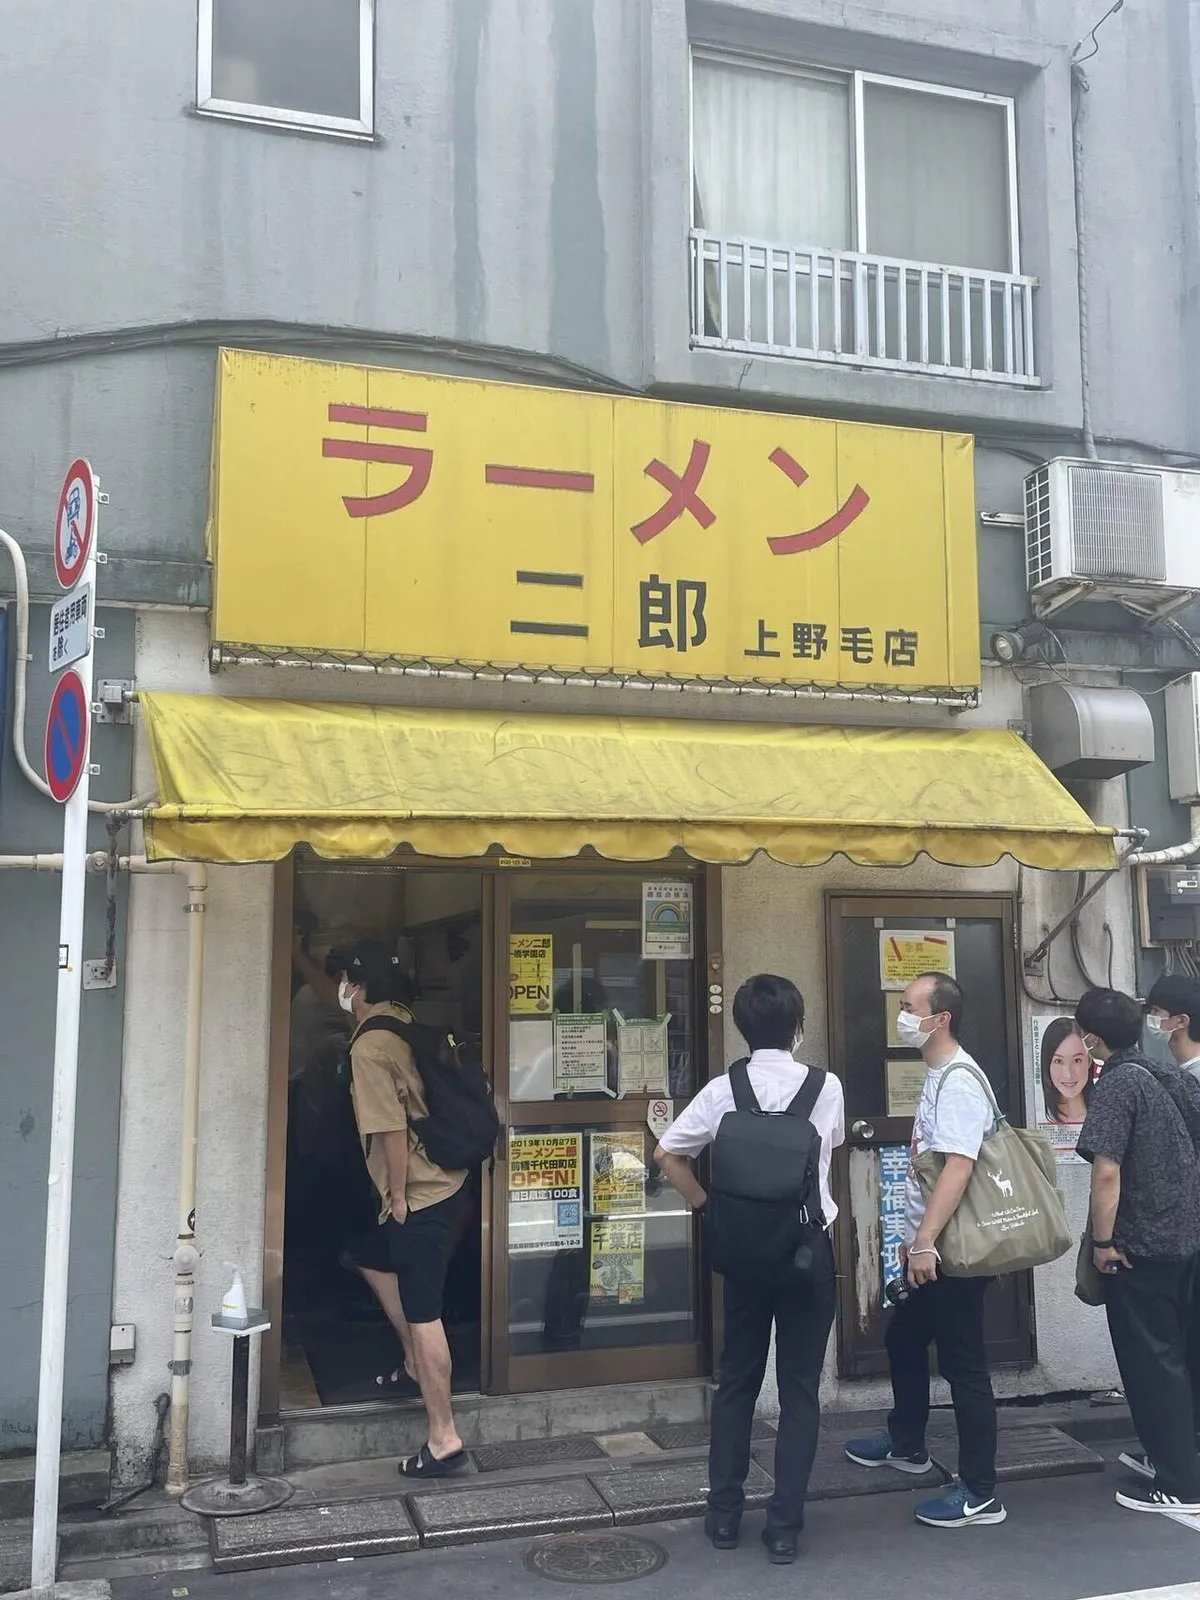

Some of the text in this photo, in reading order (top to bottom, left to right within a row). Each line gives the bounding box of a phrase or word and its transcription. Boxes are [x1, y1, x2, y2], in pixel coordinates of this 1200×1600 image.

[322, 403, 870, 555] ラーメン
[511, 570, 918, 668] 二郎 上野毛店
[510, 1137, 577, 1148] 2019年10月27日
[511, 1146, 577, 1159] ラーメン二郎
[511, 1158, 577, 1172] 前橋千代田町店
[511, 1169, 576, 1188] OPEN!
[881, 1150, 908, 1307] 幸福実現
[592, 1231, 643, 1251] 千葉店
